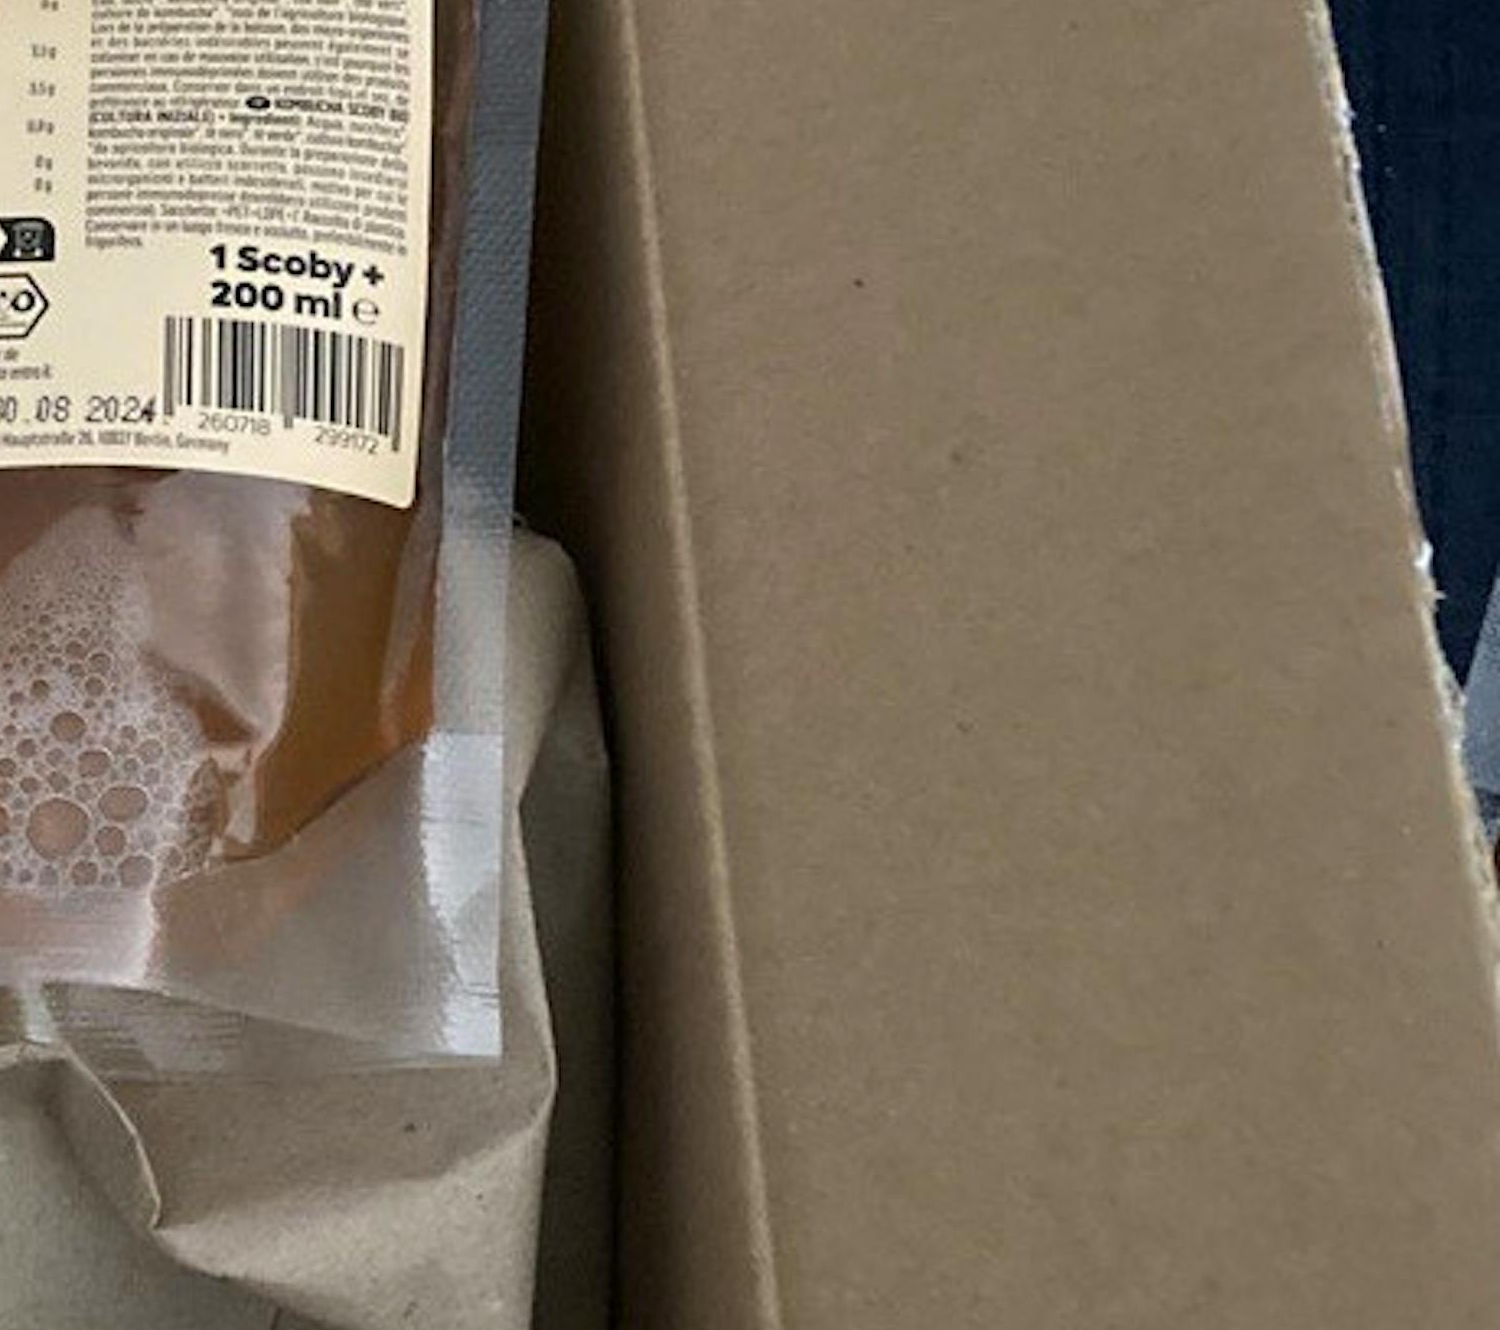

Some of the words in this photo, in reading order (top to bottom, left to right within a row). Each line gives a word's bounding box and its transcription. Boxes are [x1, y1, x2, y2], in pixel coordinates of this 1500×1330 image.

[209, 244, 226, 269] 1
[237, 246, 355, 288] Scoby
[363, 265, 384, 286] +
[211, 280, 284, 311] 200
[294, 291, 342, 319] ml
[200, 411, 272, 435] 260718
[313, 425, 380, 455] 299172
